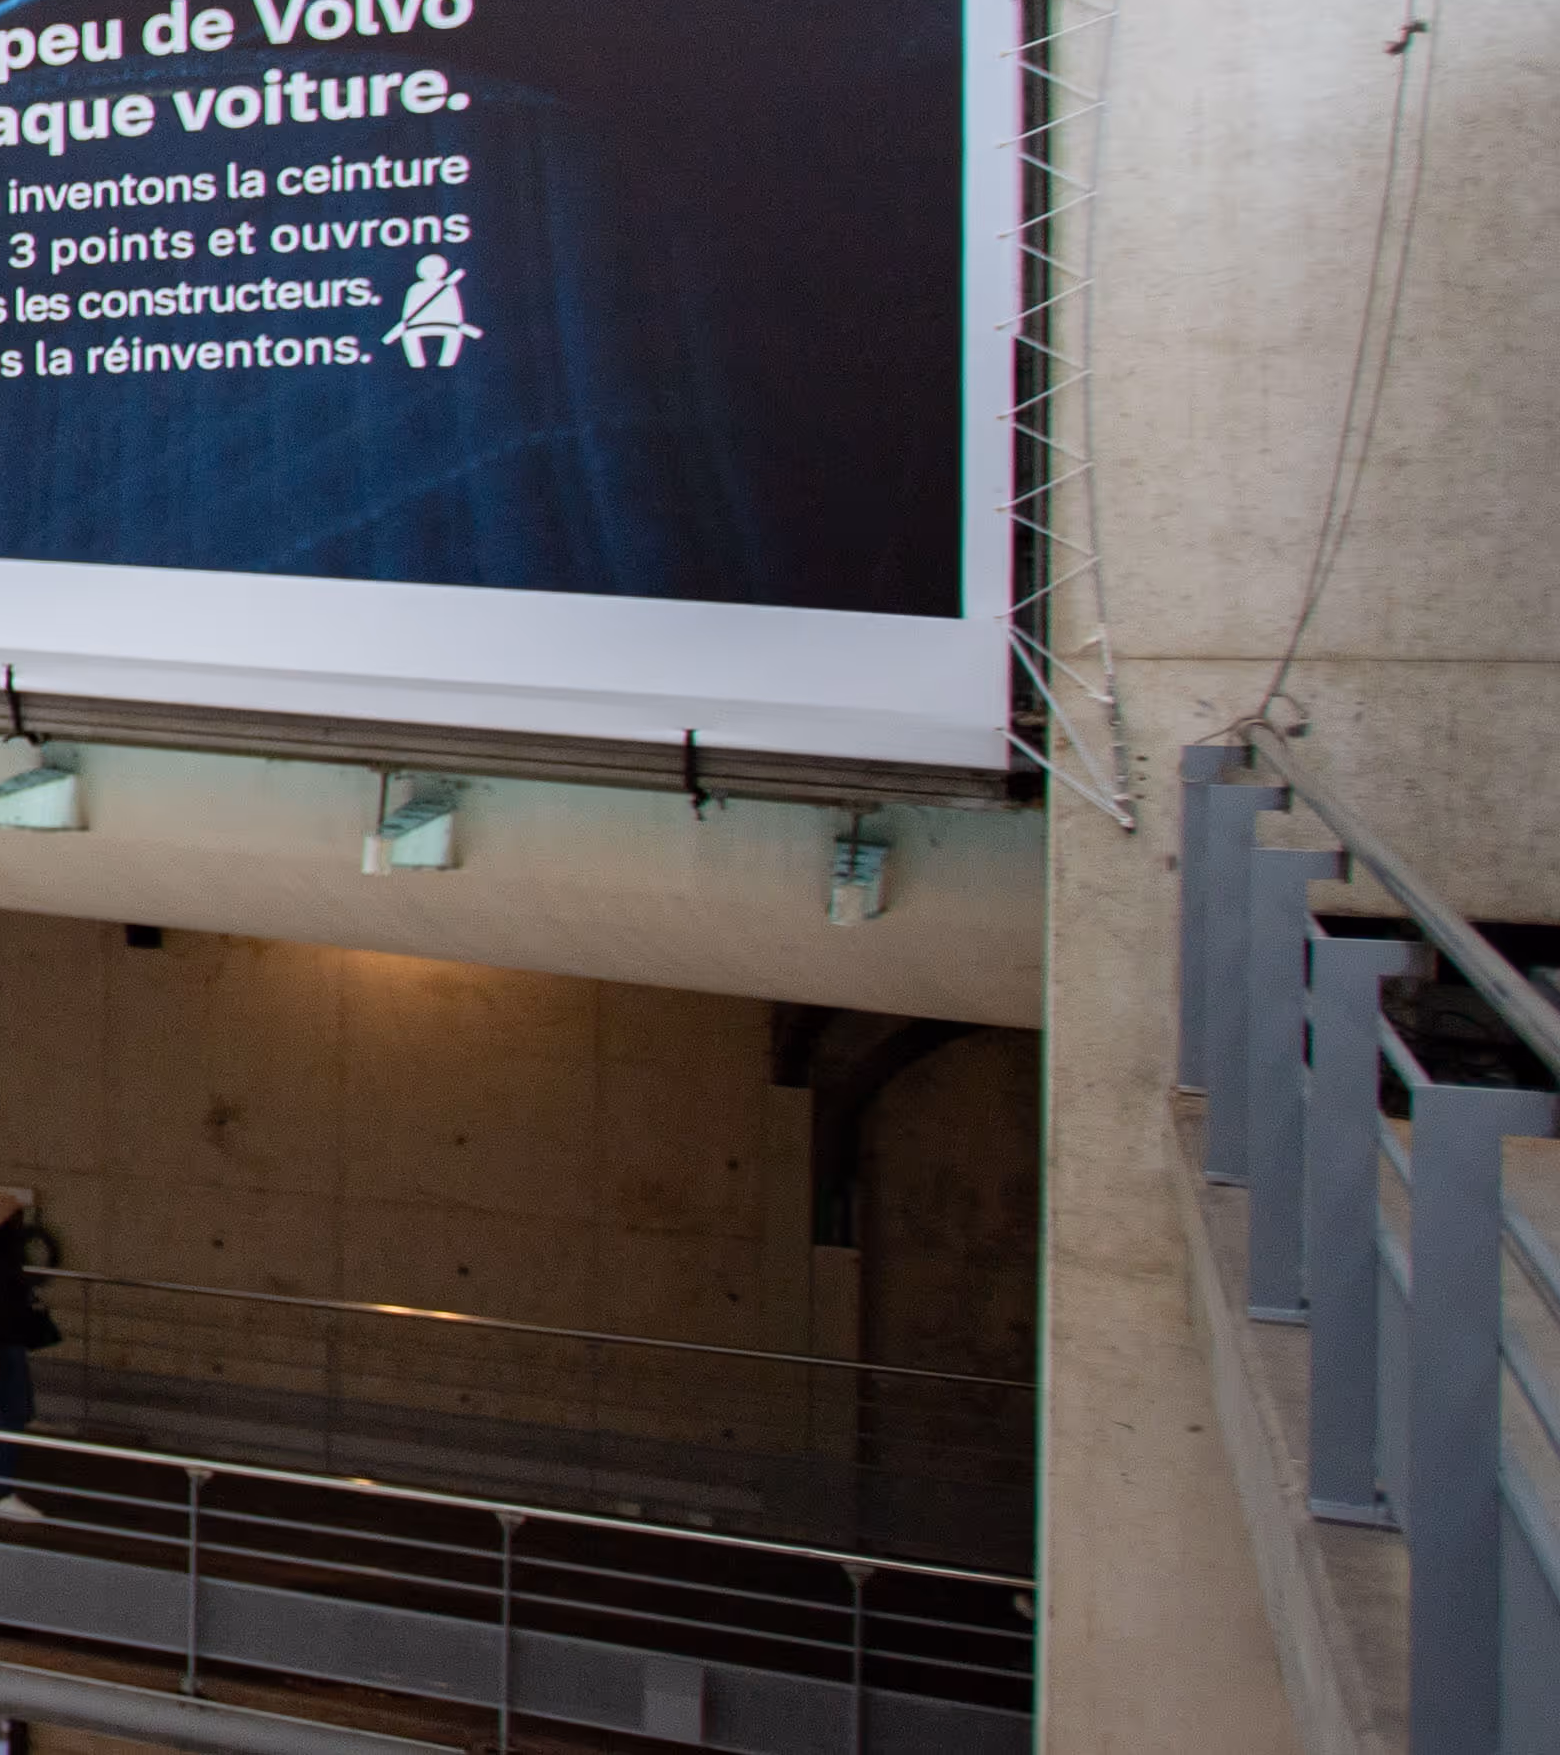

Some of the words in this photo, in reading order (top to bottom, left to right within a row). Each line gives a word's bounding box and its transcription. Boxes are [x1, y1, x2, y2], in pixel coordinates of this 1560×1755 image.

[173, 69, 469, 131] voiture.
[9, 174, 216, 213] inventons
[228, 163, 264, 198] la
[277, 156, 468, 195] ceinture
[9, 233, 35, 268] 3
[52, 228, 193, 274] points
[209, 222, 254, 256] et
[271, 215, 469, 252] ouvrons
[16, 287, 70, 321] les
[79, 278, 380, 319] constructeurs.
[37, 341, 72, 375] la
[86, 327, 372, 375] réinventons.
